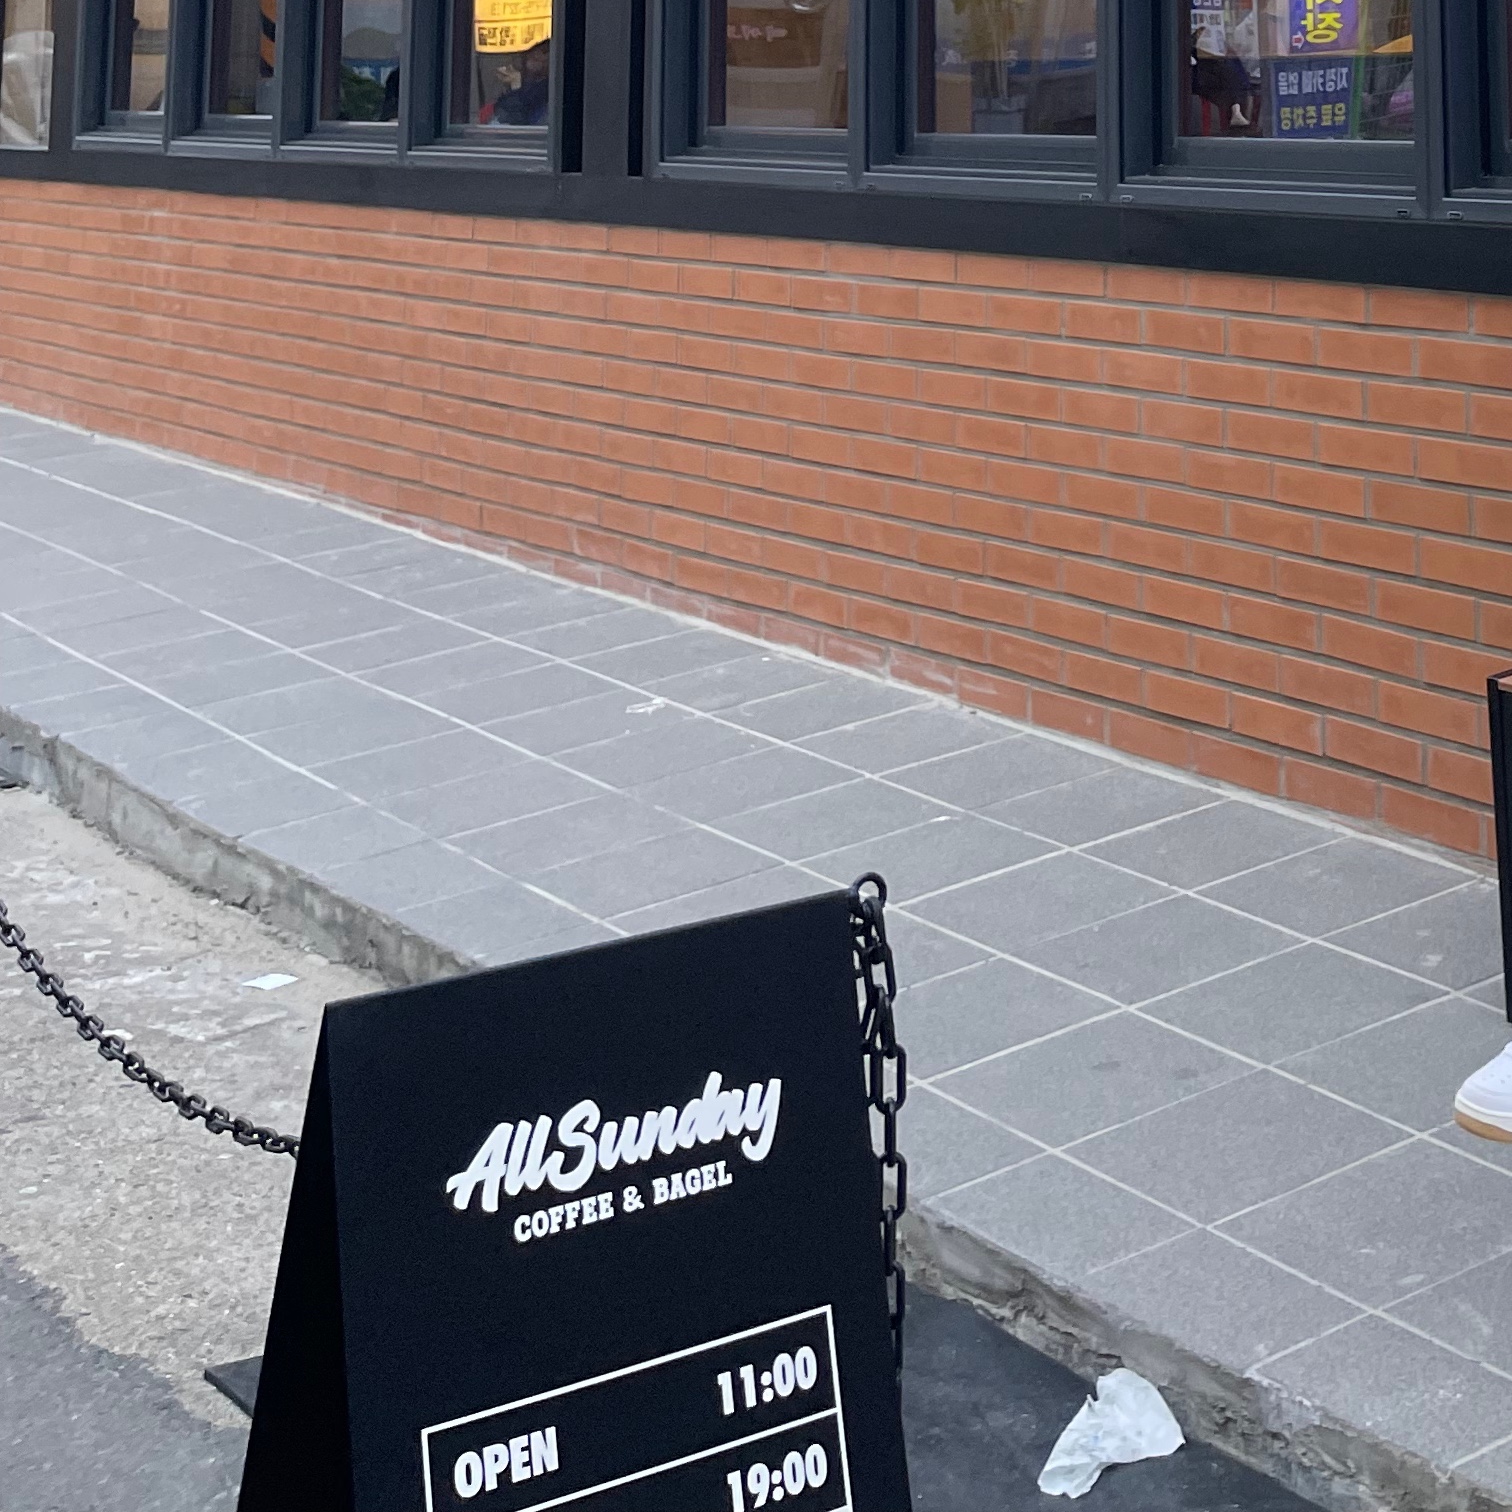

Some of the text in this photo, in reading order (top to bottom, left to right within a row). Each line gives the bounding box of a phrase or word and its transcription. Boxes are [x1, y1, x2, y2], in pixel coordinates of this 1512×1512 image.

[513, 1160, 732, 1243] COFFEE & BAGEL
[454, 1345, 817, 1498] OPEN 11:00
[727, 1443, 828, 1512] 19:00
